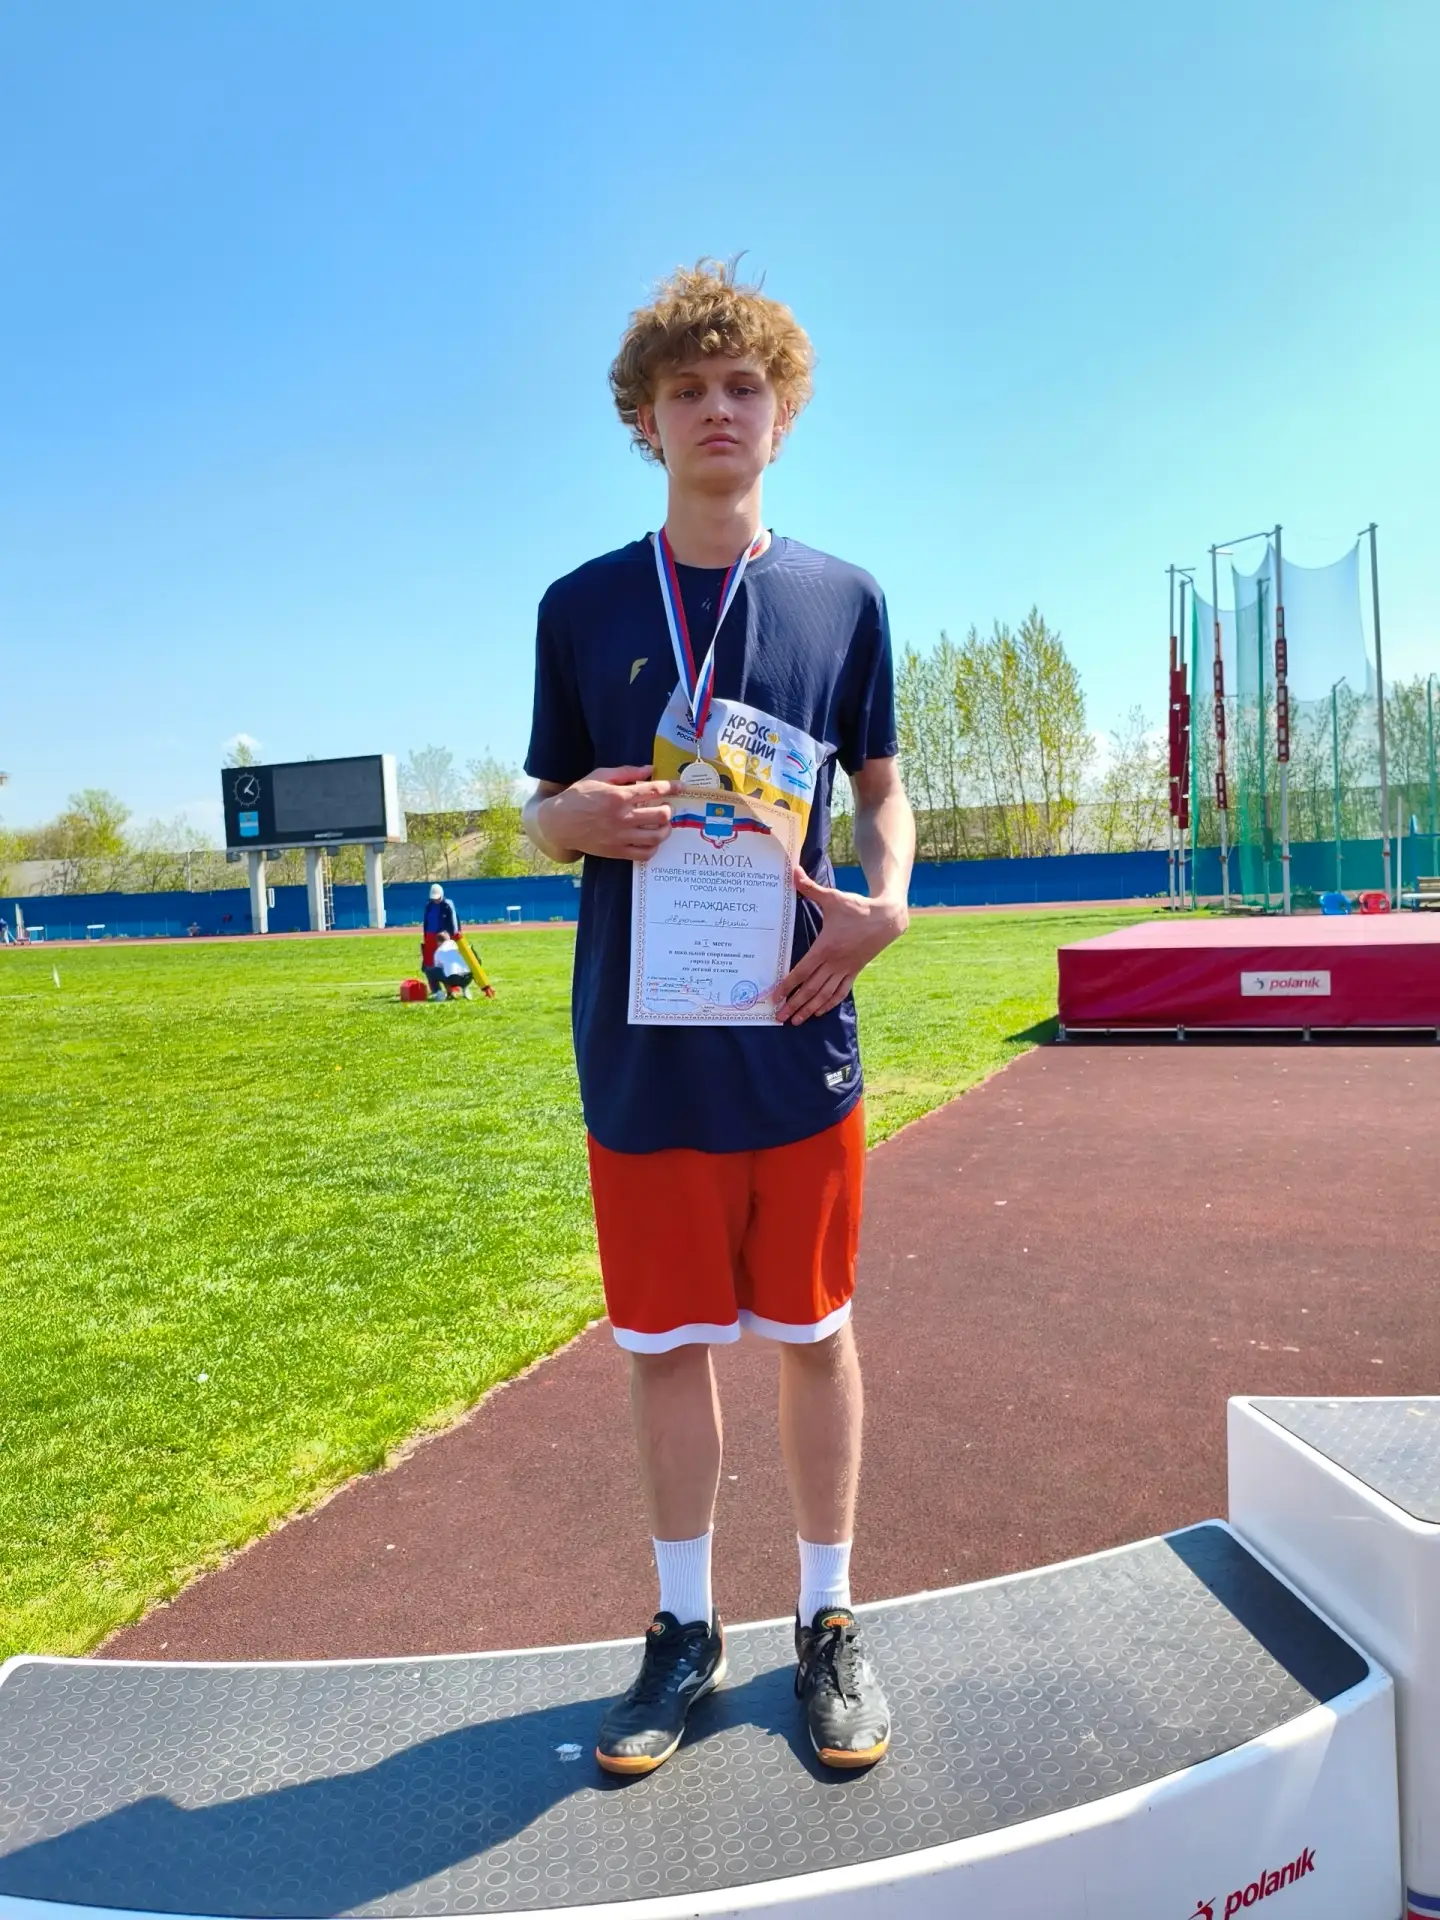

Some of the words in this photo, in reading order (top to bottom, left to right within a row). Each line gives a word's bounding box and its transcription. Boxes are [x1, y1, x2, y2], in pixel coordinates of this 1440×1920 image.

[727, 714, 770, 742] КРОСС
[720, 728, 776, 761] НАЦИИ
[683, 852, 753, 868] ГРАМОТА
[650, 867, 697, 875] УПРАВЛЕНИЕ
[698, 869, 746, 879] ФИЗИЧЕСКОЙ
[654, 875, 683, 883] СПОРТА
[743, 879, 778, 888] ПОЛИТИКИ
[689, 884, 717, 892] ГОРОДА
[718, 886, 745, 894] КАЛУГИ
[674, 899, 759, 913] НАГРАЖДАЕТСЯ:
[711, 958, 733, 966] Калуги
[1269, 976, 1321, 991] polanik
[1224, 1846, 1317, 1920] polanik
